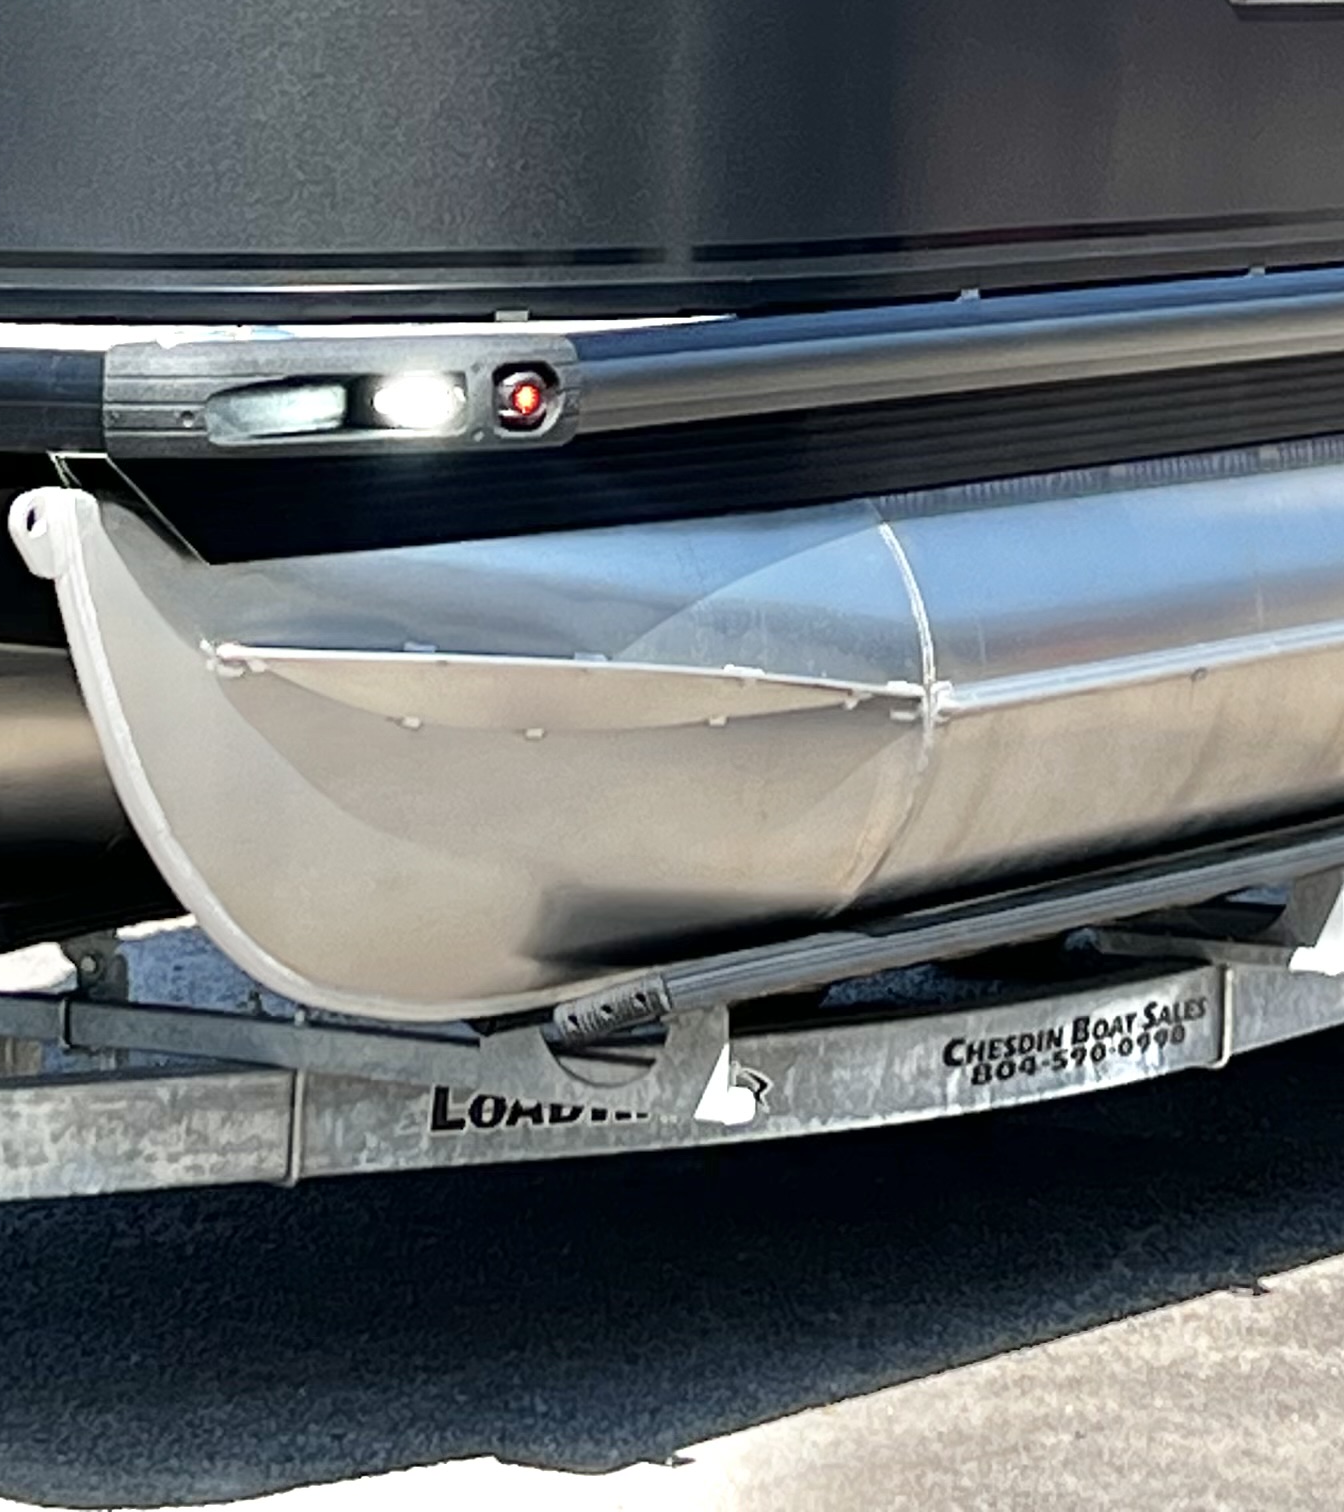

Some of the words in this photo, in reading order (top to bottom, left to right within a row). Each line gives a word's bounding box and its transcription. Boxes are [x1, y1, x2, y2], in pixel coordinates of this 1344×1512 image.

[943, 1026, 1063, 1067] CHESDIN
[1071, 1013, 1138, 1044] BOAT
[1142, 998, 1207, 1029] SALES
